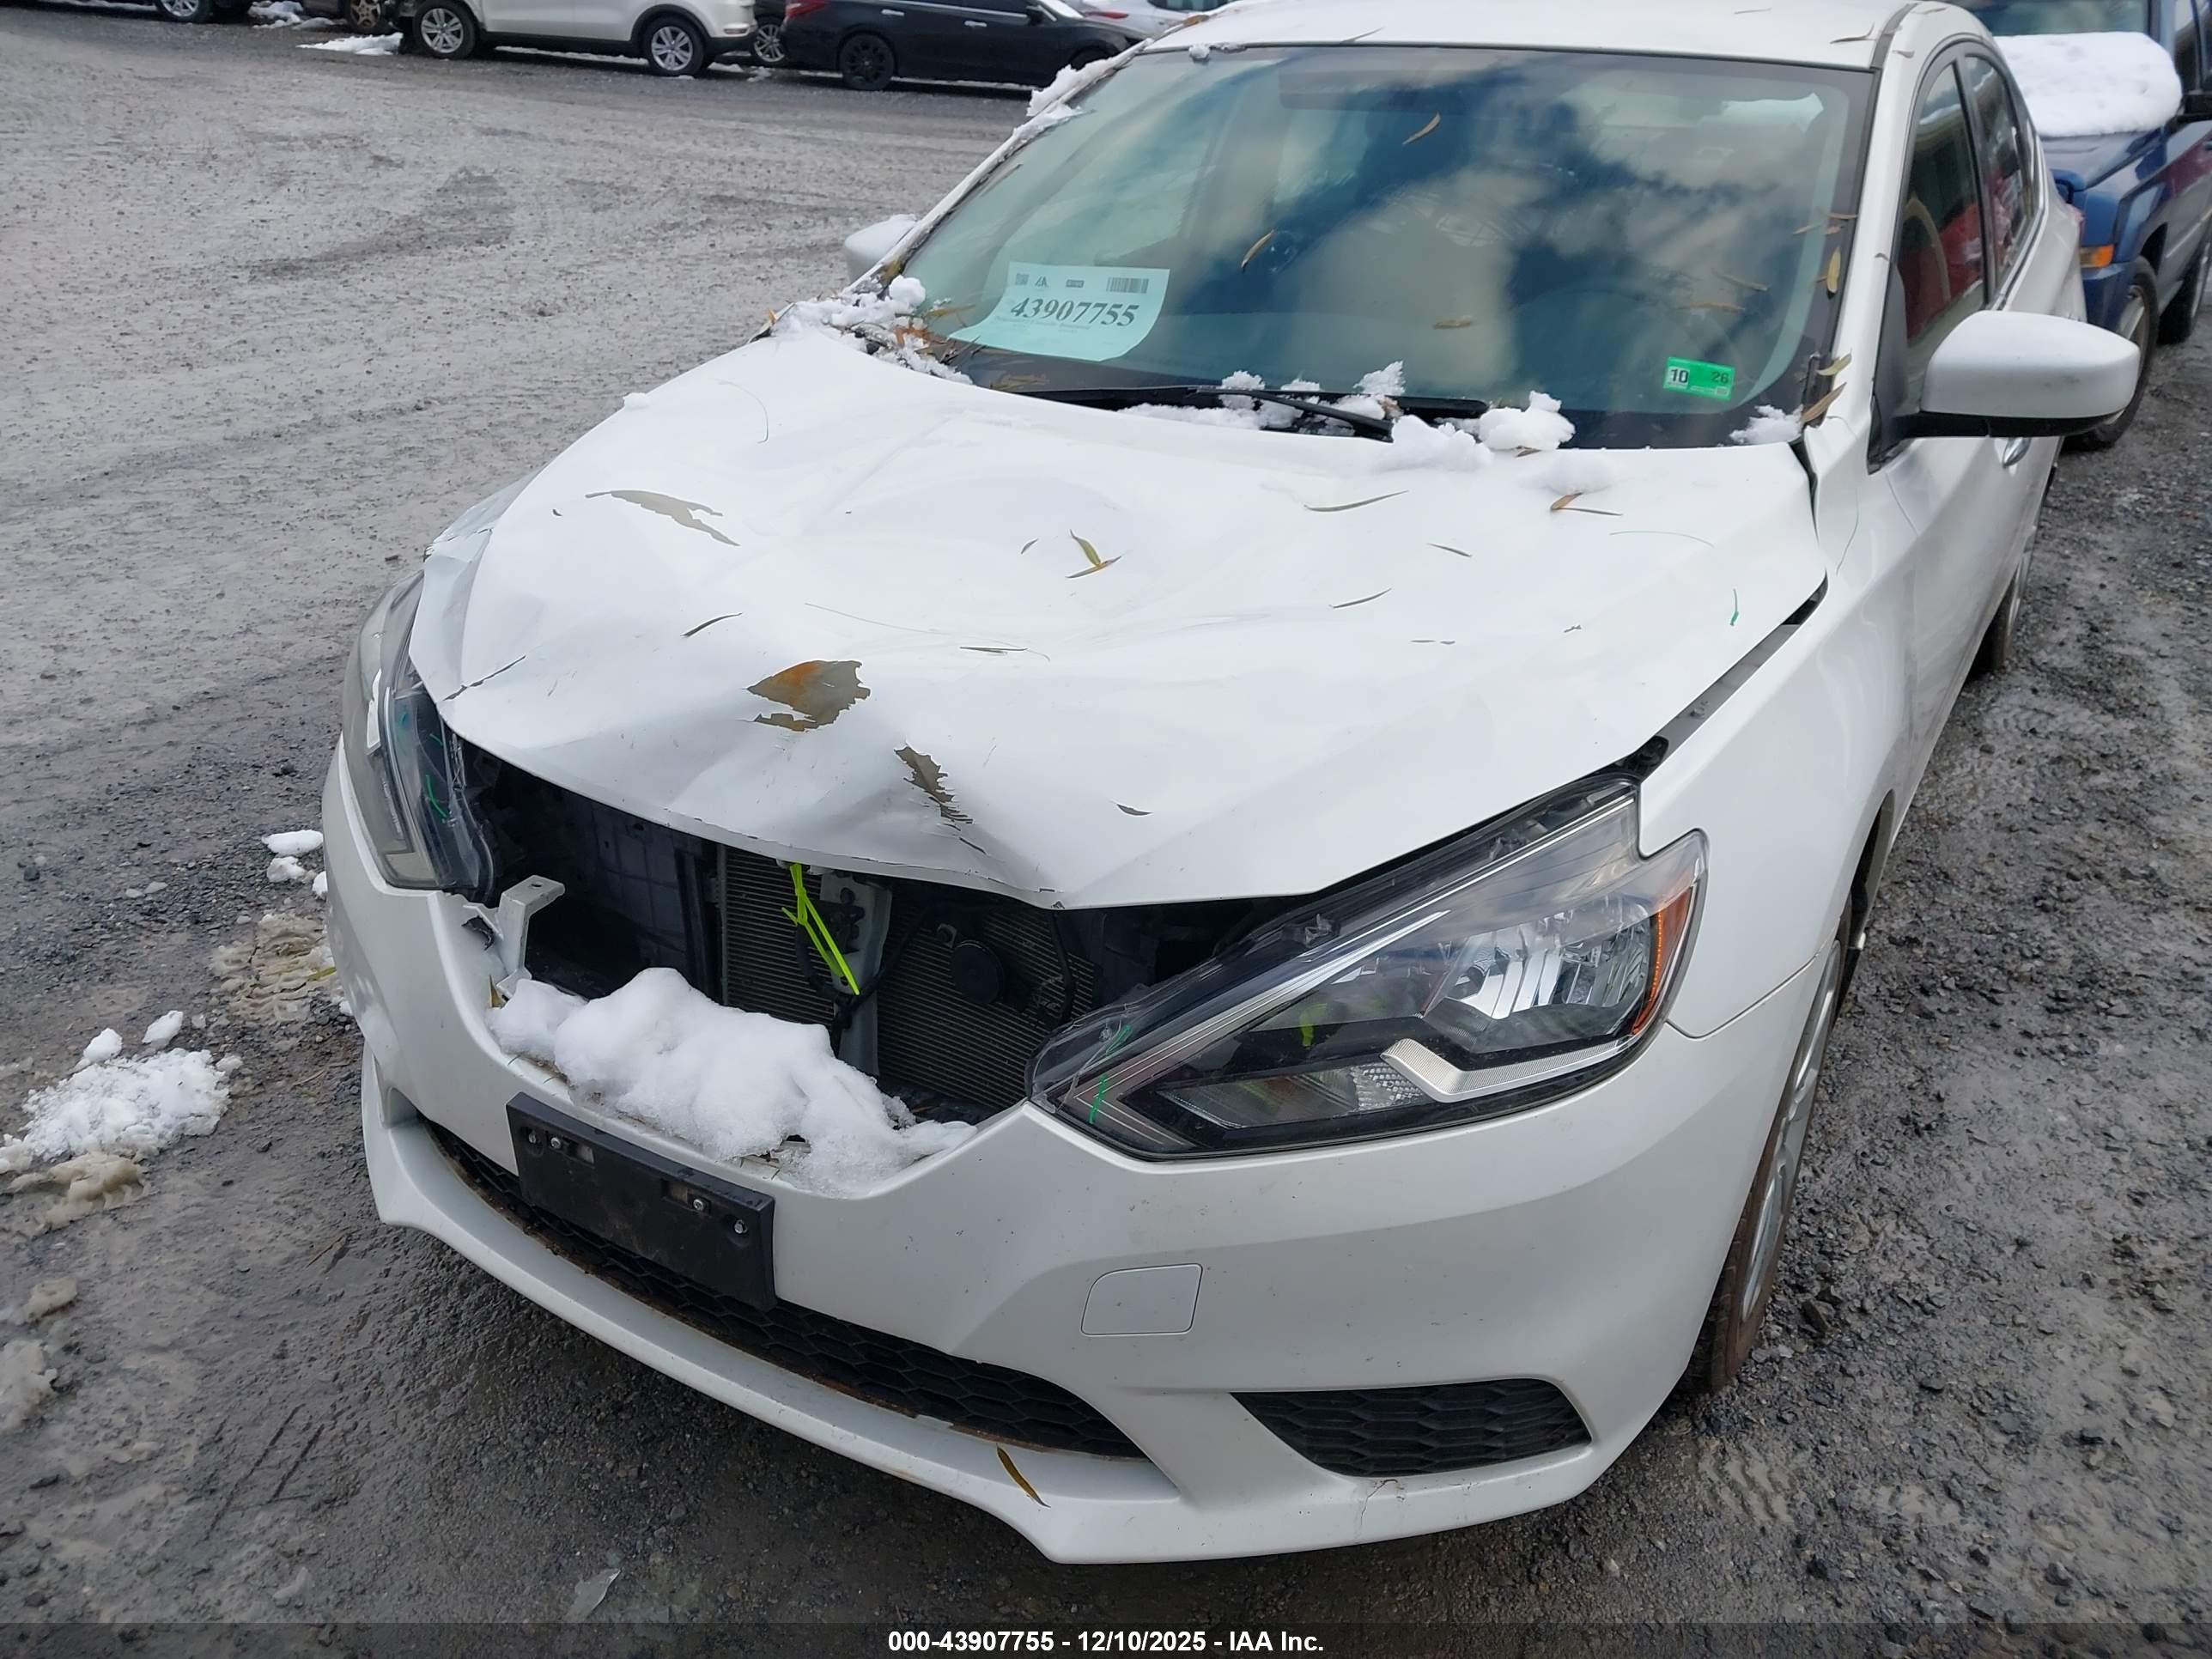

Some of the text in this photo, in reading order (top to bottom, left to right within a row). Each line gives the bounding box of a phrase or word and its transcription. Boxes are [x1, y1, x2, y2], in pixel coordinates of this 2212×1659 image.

[1010, 296, 1140, 327] 43907755
[1670, 368, 1729, 385] 10 26
